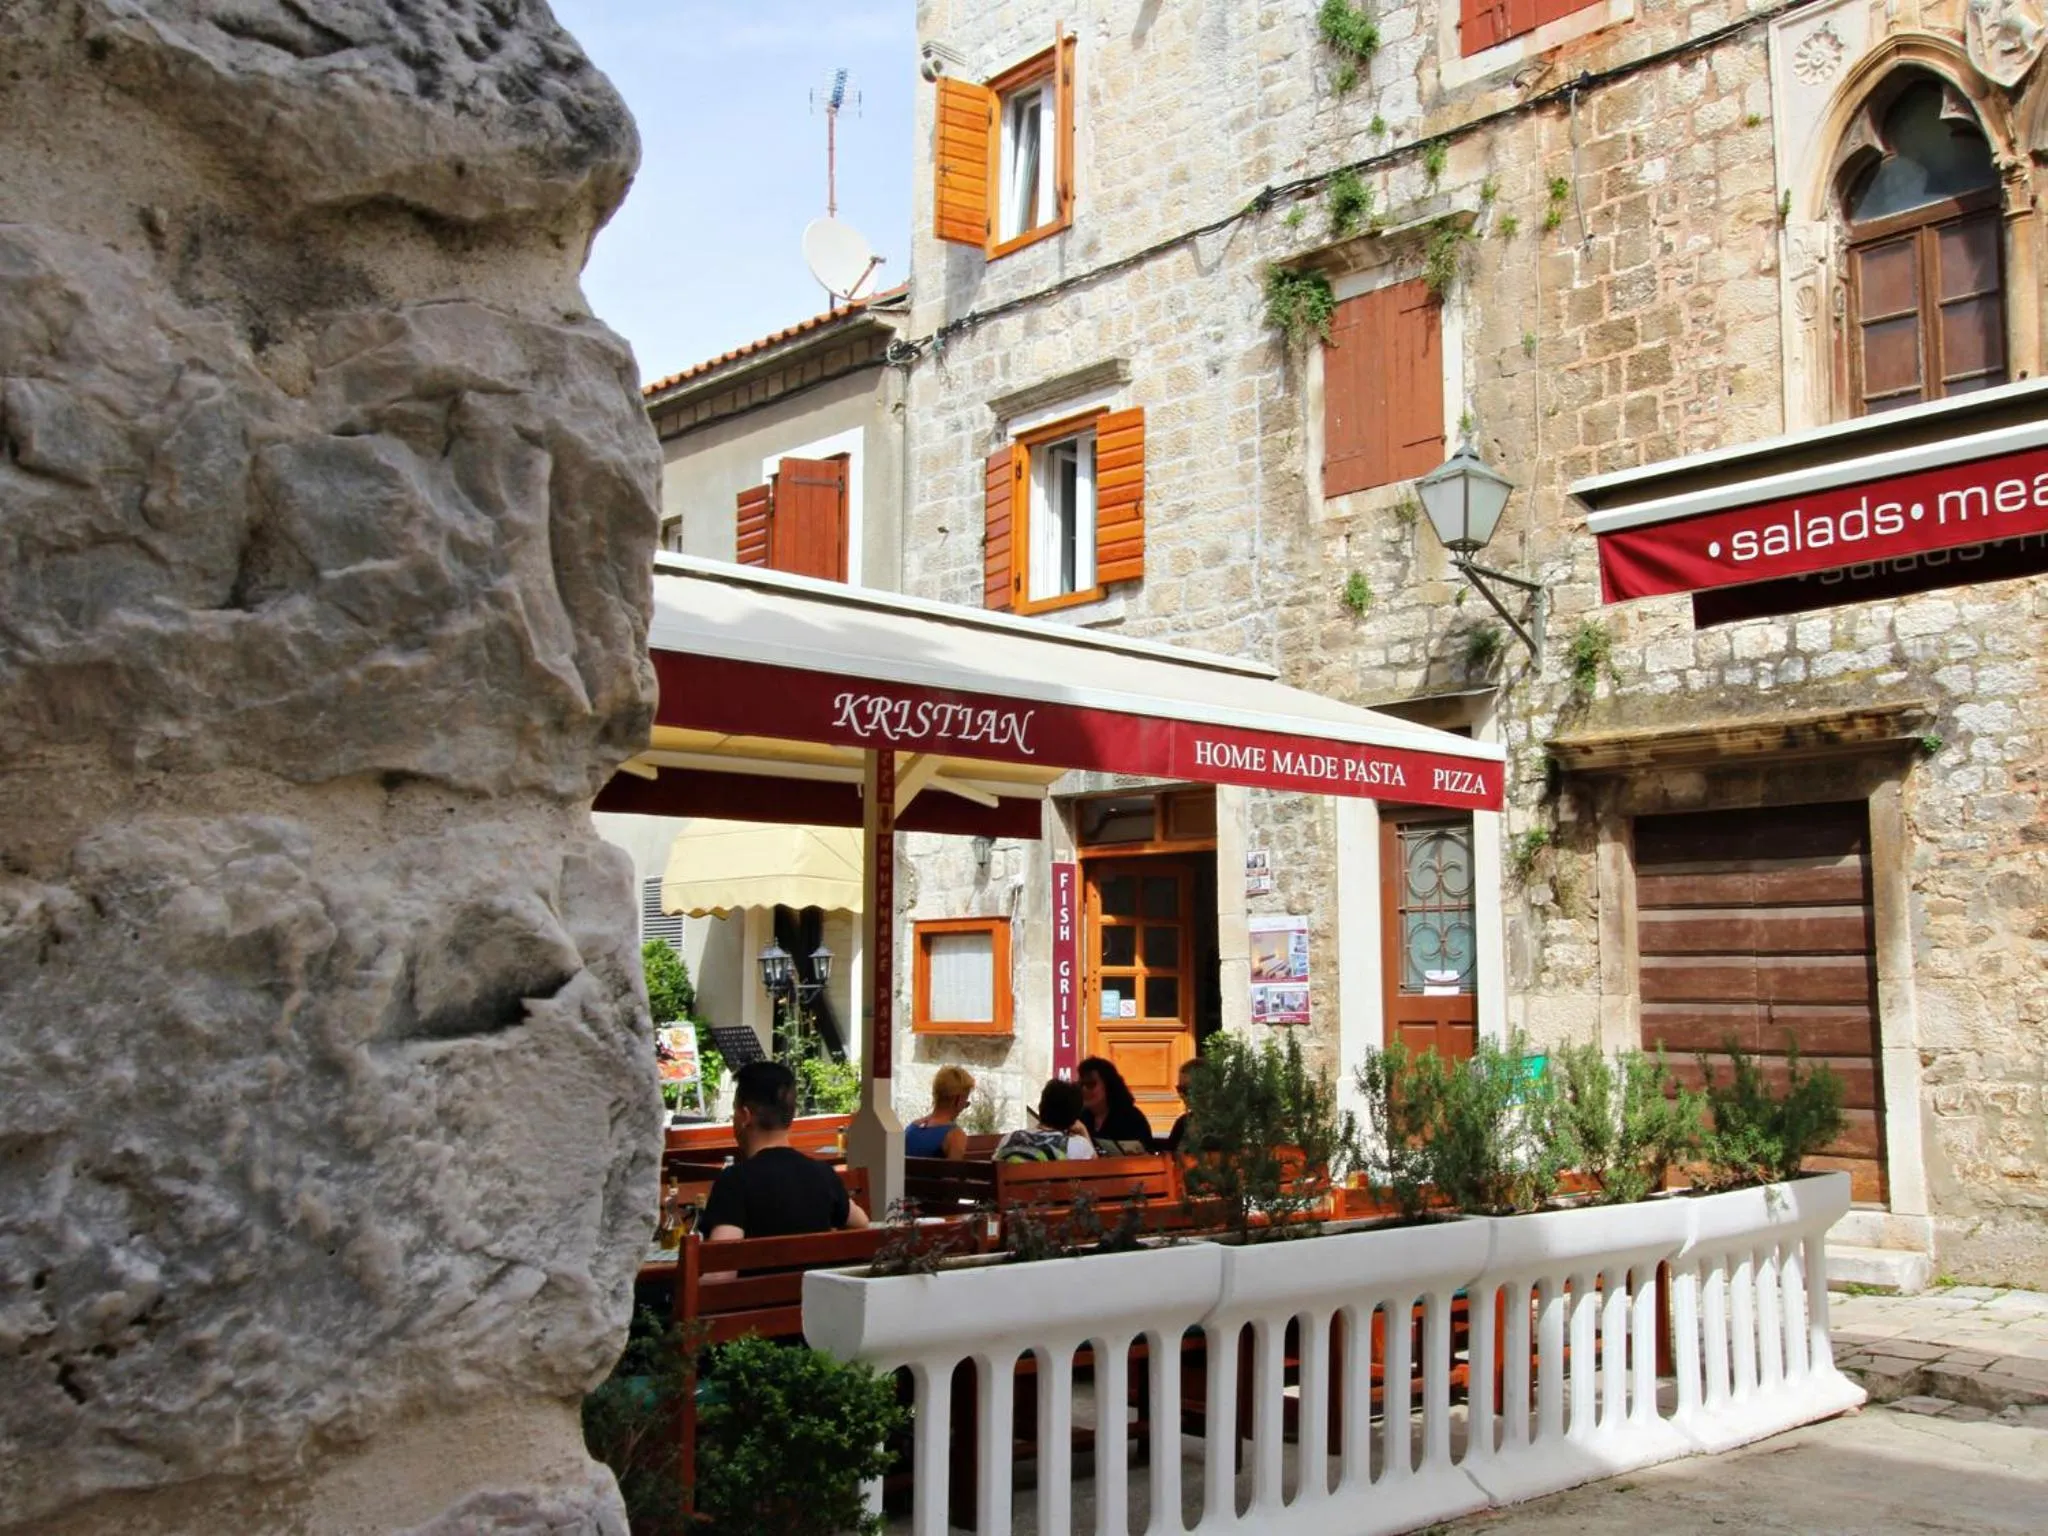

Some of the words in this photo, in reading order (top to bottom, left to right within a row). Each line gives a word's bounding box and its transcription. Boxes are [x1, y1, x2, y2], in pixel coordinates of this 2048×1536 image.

[1731, 496, 1905, 561] salads
[832, 692, 1035, 754] KRISTIAN
[1195, 741, 1266, 772] HOME
[1272, 750, 1339, 779] MADE
[1343, 759, 1406, 786] PASTA
[1432, 768, 1487, 795] PIZZA
[1059, 873, 1070, 941] FISH
[1059, 961, 1070, 1048] GRILL
